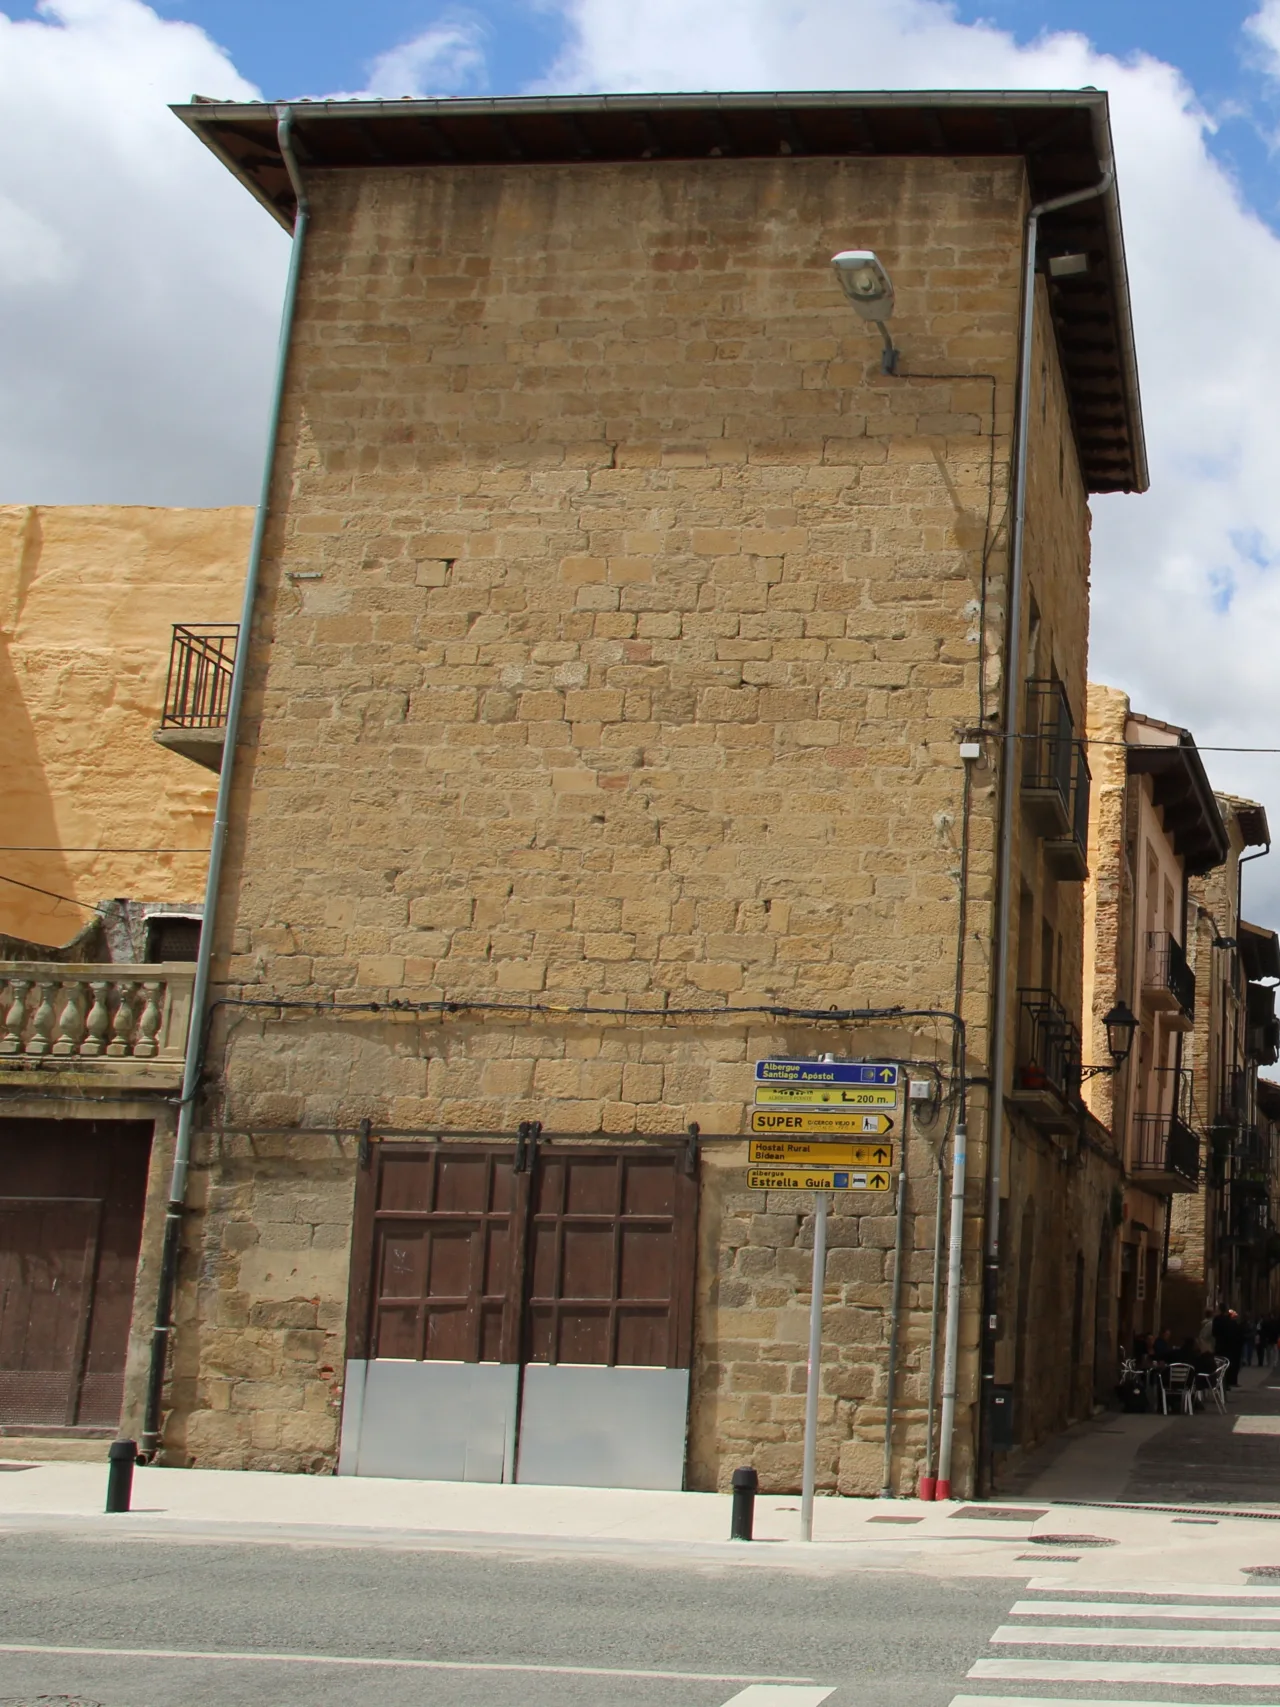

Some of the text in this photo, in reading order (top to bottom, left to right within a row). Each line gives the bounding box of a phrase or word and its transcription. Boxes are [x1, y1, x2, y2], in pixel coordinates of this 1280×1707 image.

[763, 1063, 800, 1074] Albergue
[762, 1071, 834, 1081] Santiago Apóstol
[857, 1095, 889, 1104] 200 m.
[757, 1116, 803, 1128] SUPER
[755, 1144, 784, 1152] Hostal
[755, 1152, 785, 1160] Bidean
[751, 1177, 831, 1188] Estrella Guía
